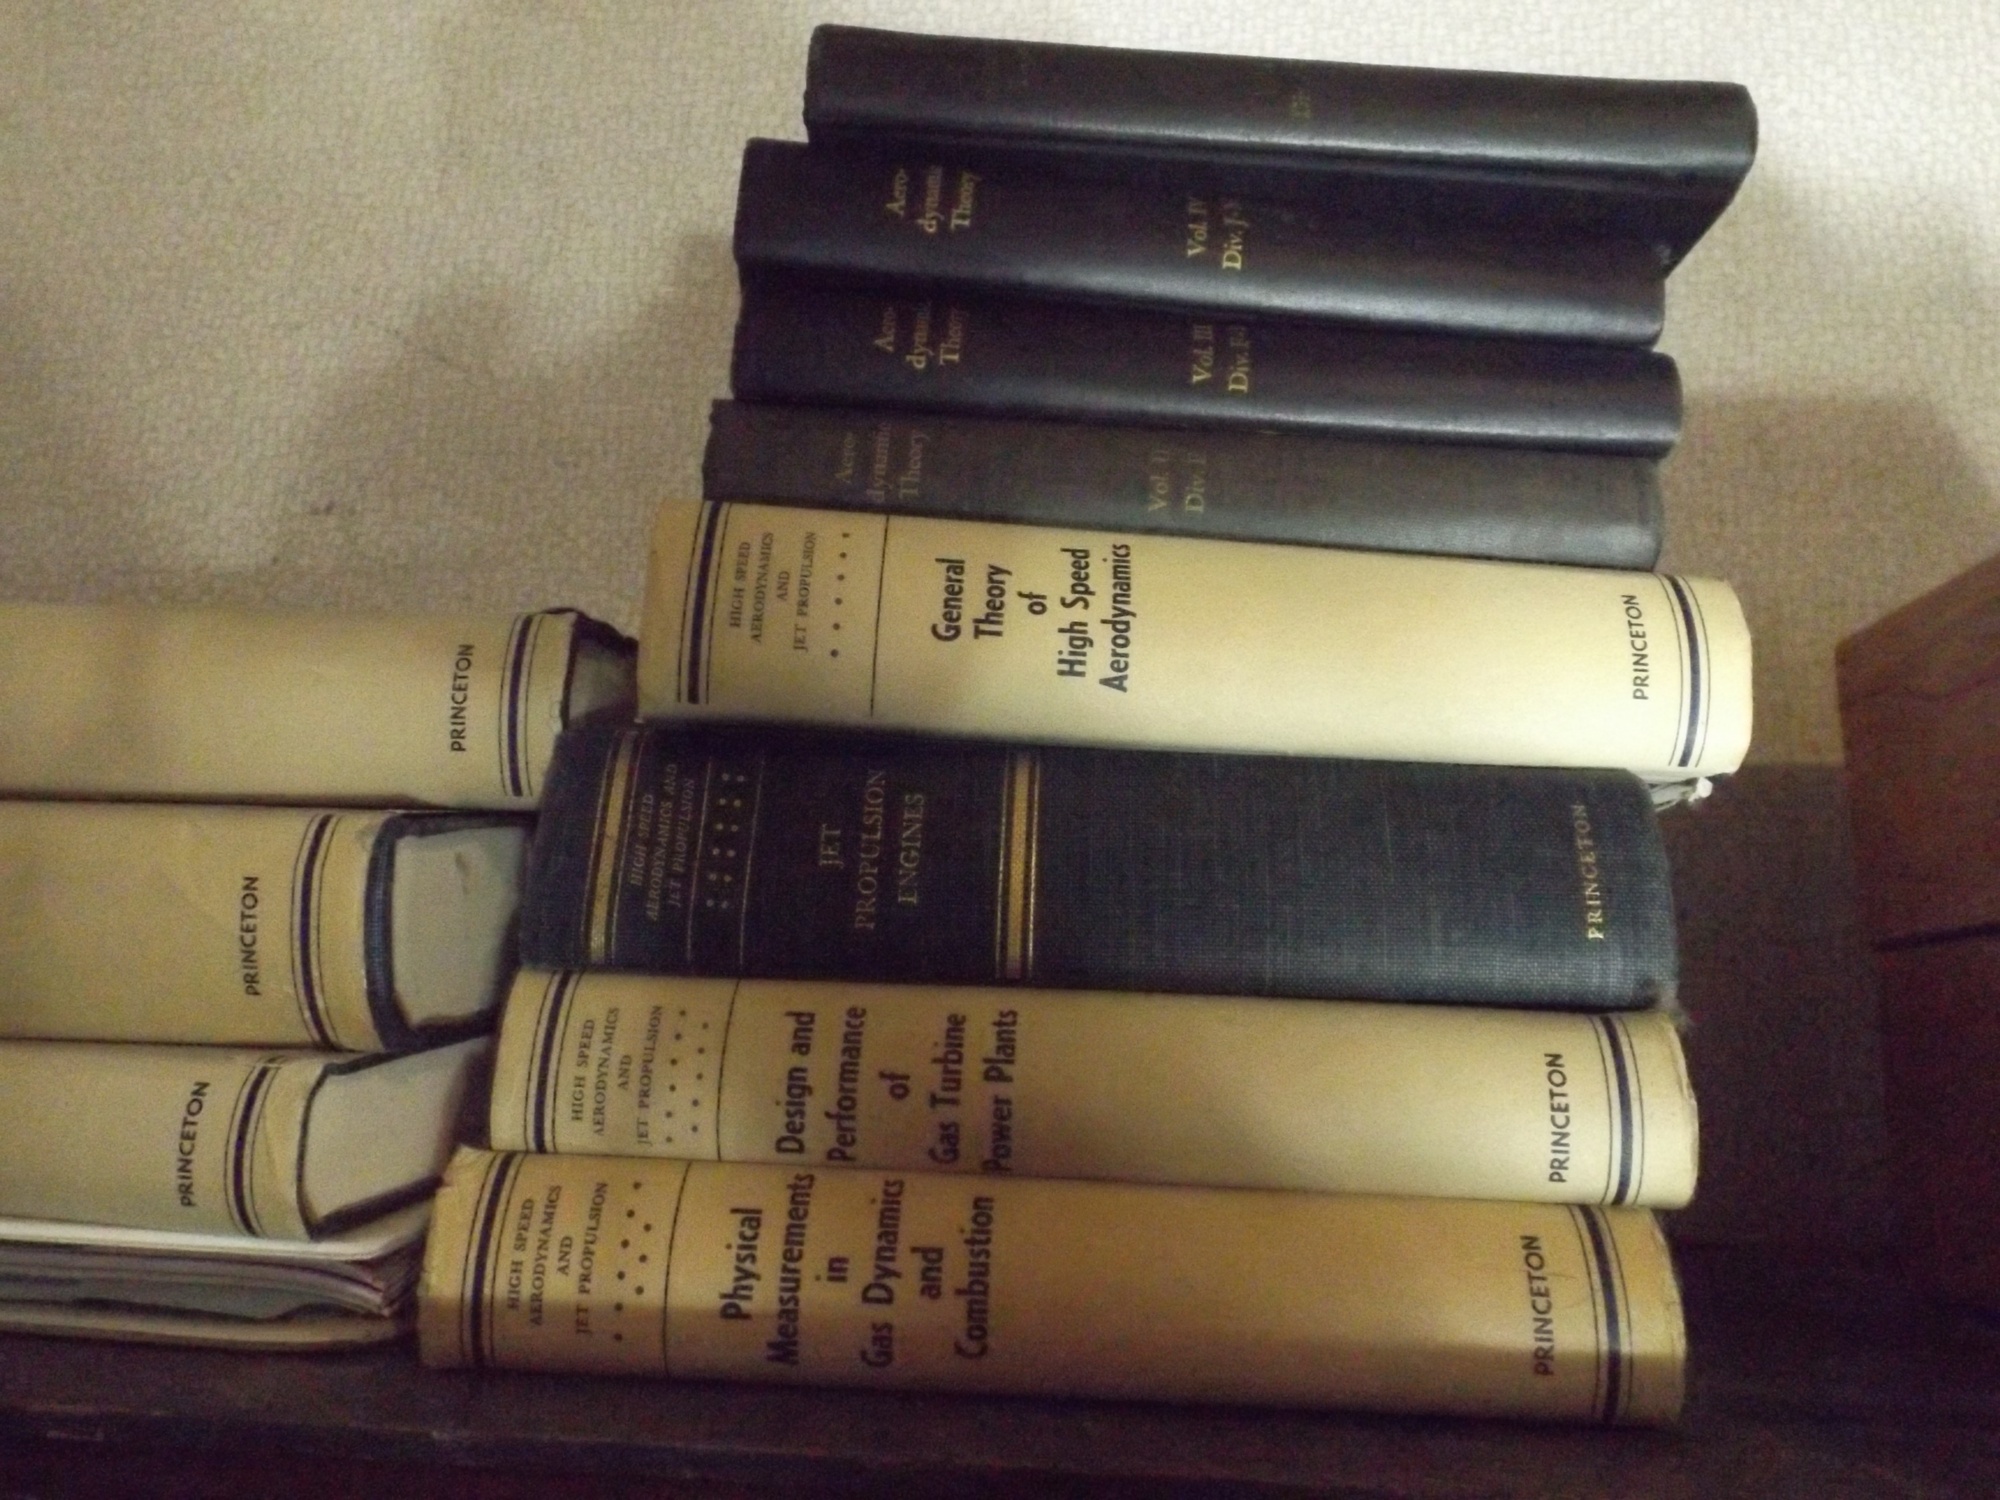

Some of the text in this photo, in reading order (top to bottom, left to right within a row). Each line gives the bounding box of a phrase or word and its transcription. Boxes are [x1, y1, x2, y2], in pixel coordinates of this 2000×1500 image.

[885, 168, 909, 219] Aero-
[949, 171, 982, 231] Theory
[1186, 221, 1208, 258] Vol.
[1222, 230, 1244, 271] Div.
[1189, 346, 1214, 386] Vol.
[1225, 352, 1250, 395] Div.
[1147, 473, 1170, 512] Vol.
[1184, 470, 1206, 513] Div.
[729, 541, 751, 629] HIGH SPEED
[751, 531, 774, 644] AERODYNAMICS
[775, 570, 791, 601] AND
[793, 531, 817, 653] JET PROPULSION
[929, 557, 967, 642] General
[971, 563, 1013, 640] Theory
[1016, 590, 1049, 616] of
[1055, 547, 1097, 678] High Speed
[1098, 544, 1138, 693] Aerodynamics
[449, 643, 476, 752] PRINCETON
[1621, 594, 1650, 701] PRINCETON
[629, 792, 655, 887] HIGH SPEED
[646, 763, 678, 922] AERODYNAMICS AND
[669, 778, 695, 908] JET PROPULSION
[818, 823, 845, 871] JET
[853, 769, 887, 931] PROPULSION
[898, 792, 928, 907] ENGINES
[1570, 801, 1605, 942] PRINCETON
[238, 875, 261, 997] PRINCETON
[571, 1019, 595, 1122] HIGH SPEED
[592, 1007, 620, 1137] AERODYNAMICS
[617, 1054, 633, 1091] AND
[636, 1005, 663, 1147] JET PROPULSION
[774, 1010, 816, 1155] Design and
[824, 1006, 867, 1162] Performance
[878, 1069, 911, 1101] of
[928, 1012, 967, 1164] Gas Turbine
[981, 1008, 1019, 1173] Power Plants
[1544, 1052, 1571, 1183] PRINCETON
[175, 1081, 211, 1207] PRINCETON
[507, 1197, 535, 1312] HIGH SPEED
[529, 1184, 563, 1326] AERODYNAMICS
[556, 1235, 574, 1277] AND
[575, 1182, 609, 1337] JET PROPULSION
[719, 1207, 763, 1320] Physical
[766, 1173, 816, 1365] Measurements
[814, 1256, 850, 1283] in
[861, 1179, 905, 1367] Gas Dynamics
[909, 1246, 944, 1300] and
[953, 1195, 995, 1359] Combustion
[1519, 1233, 1554, 1376] PRINCETON
